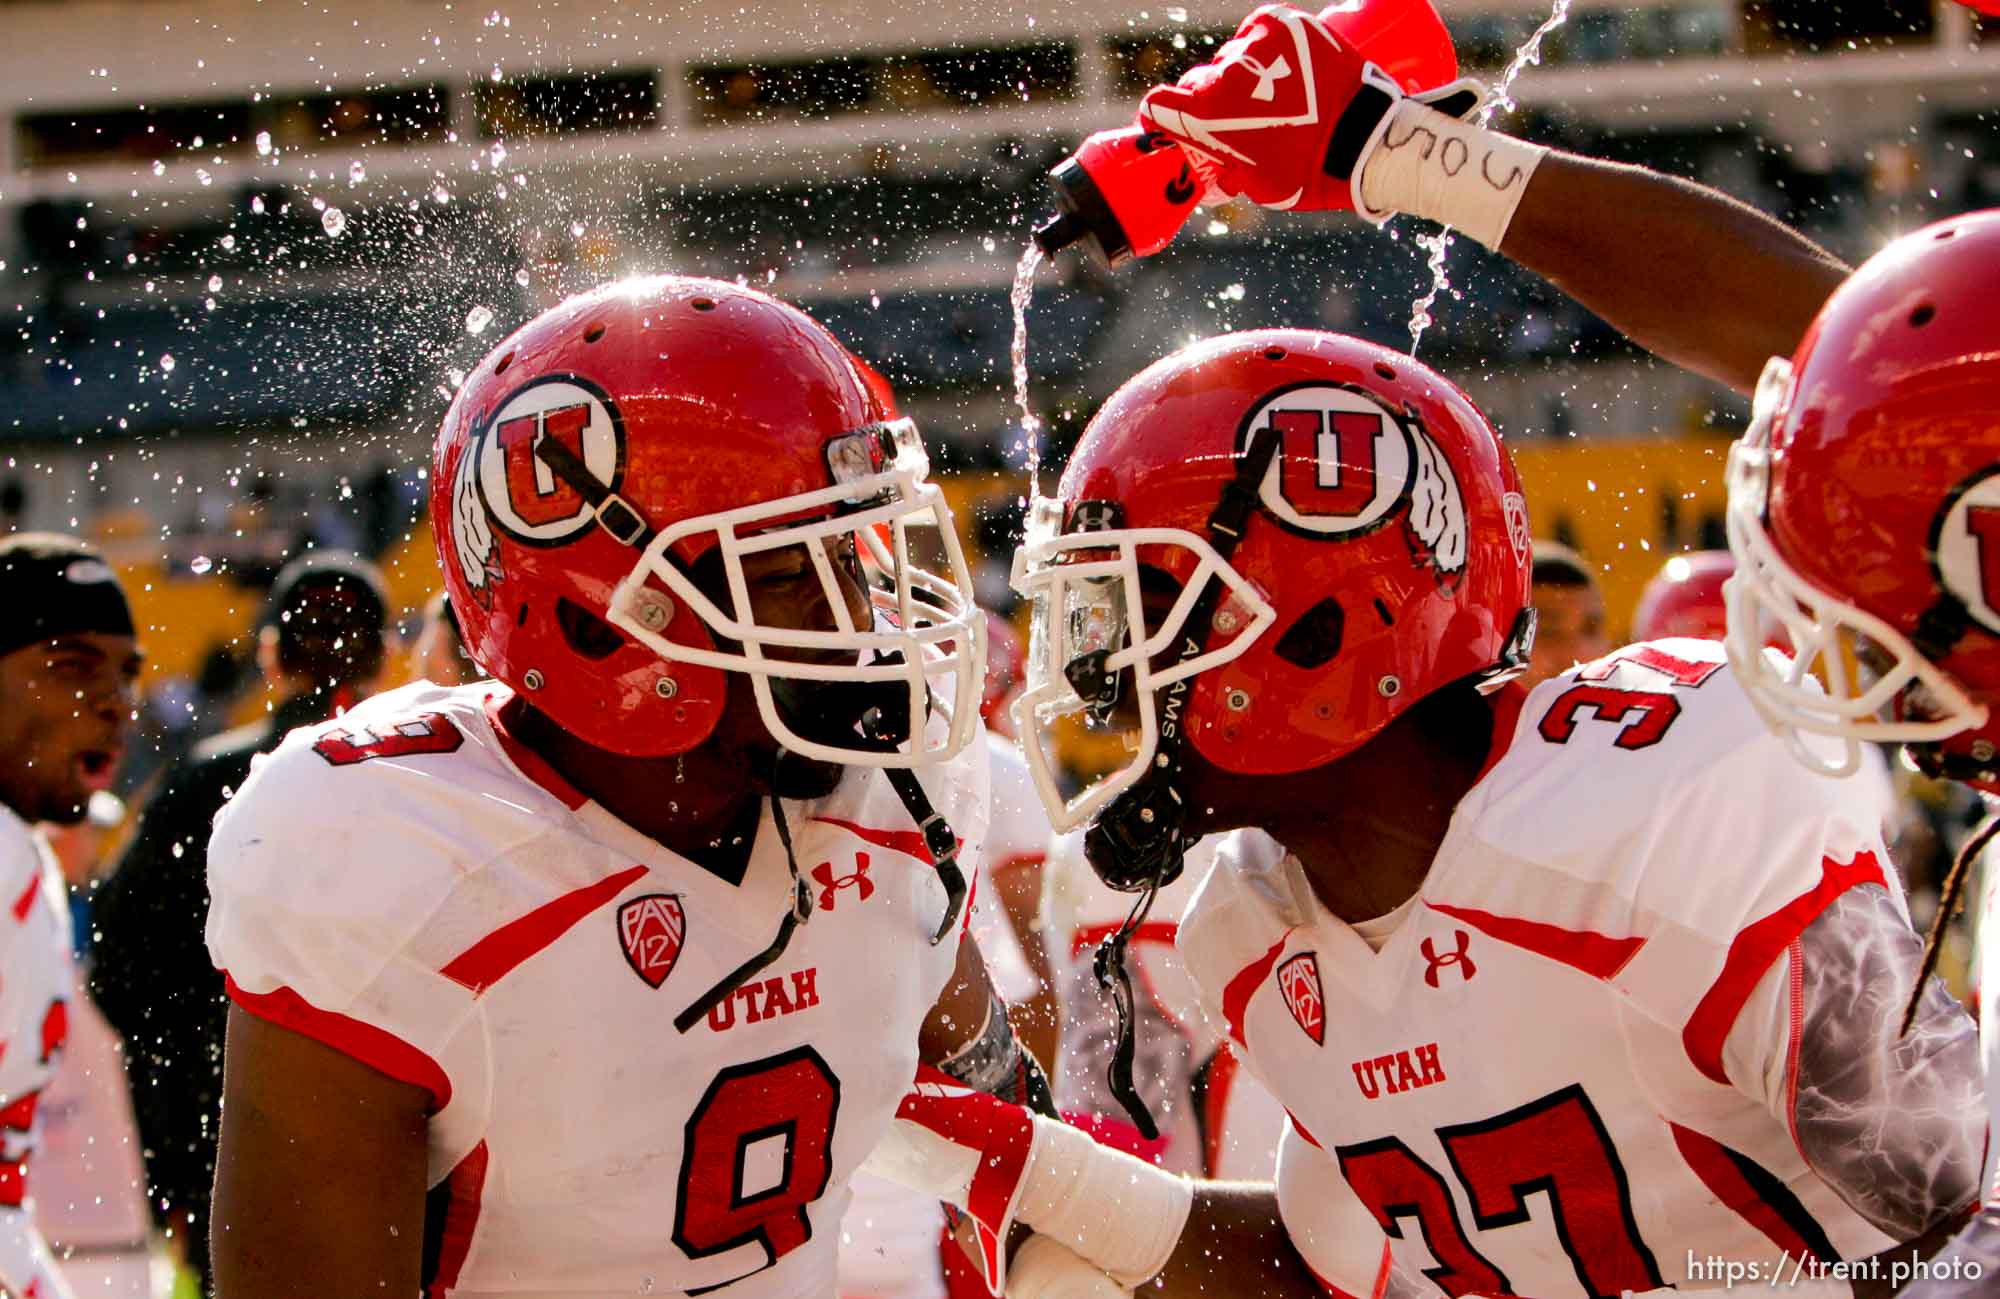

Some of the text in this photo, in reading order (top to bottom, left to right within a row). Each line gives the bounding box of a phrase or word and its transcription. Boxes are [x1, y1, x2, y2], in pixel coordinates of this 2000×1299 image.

[497, 402, 591, 528] U
[1269, 410, 1383, 517] U
[1162, 637, 1200, 739] AAMS
[621, 898, 682, 954] PAC
[639, 934, 671, 970] 12
[707, 967, 820, 1032] UTAH
[1280, 958, 1321, 1014] PAC
[1297, 993, 1321, 1028] 12
[1352, 1043, 1446, 1099] UTAH
[671, 1044, 840, 1297] 9
